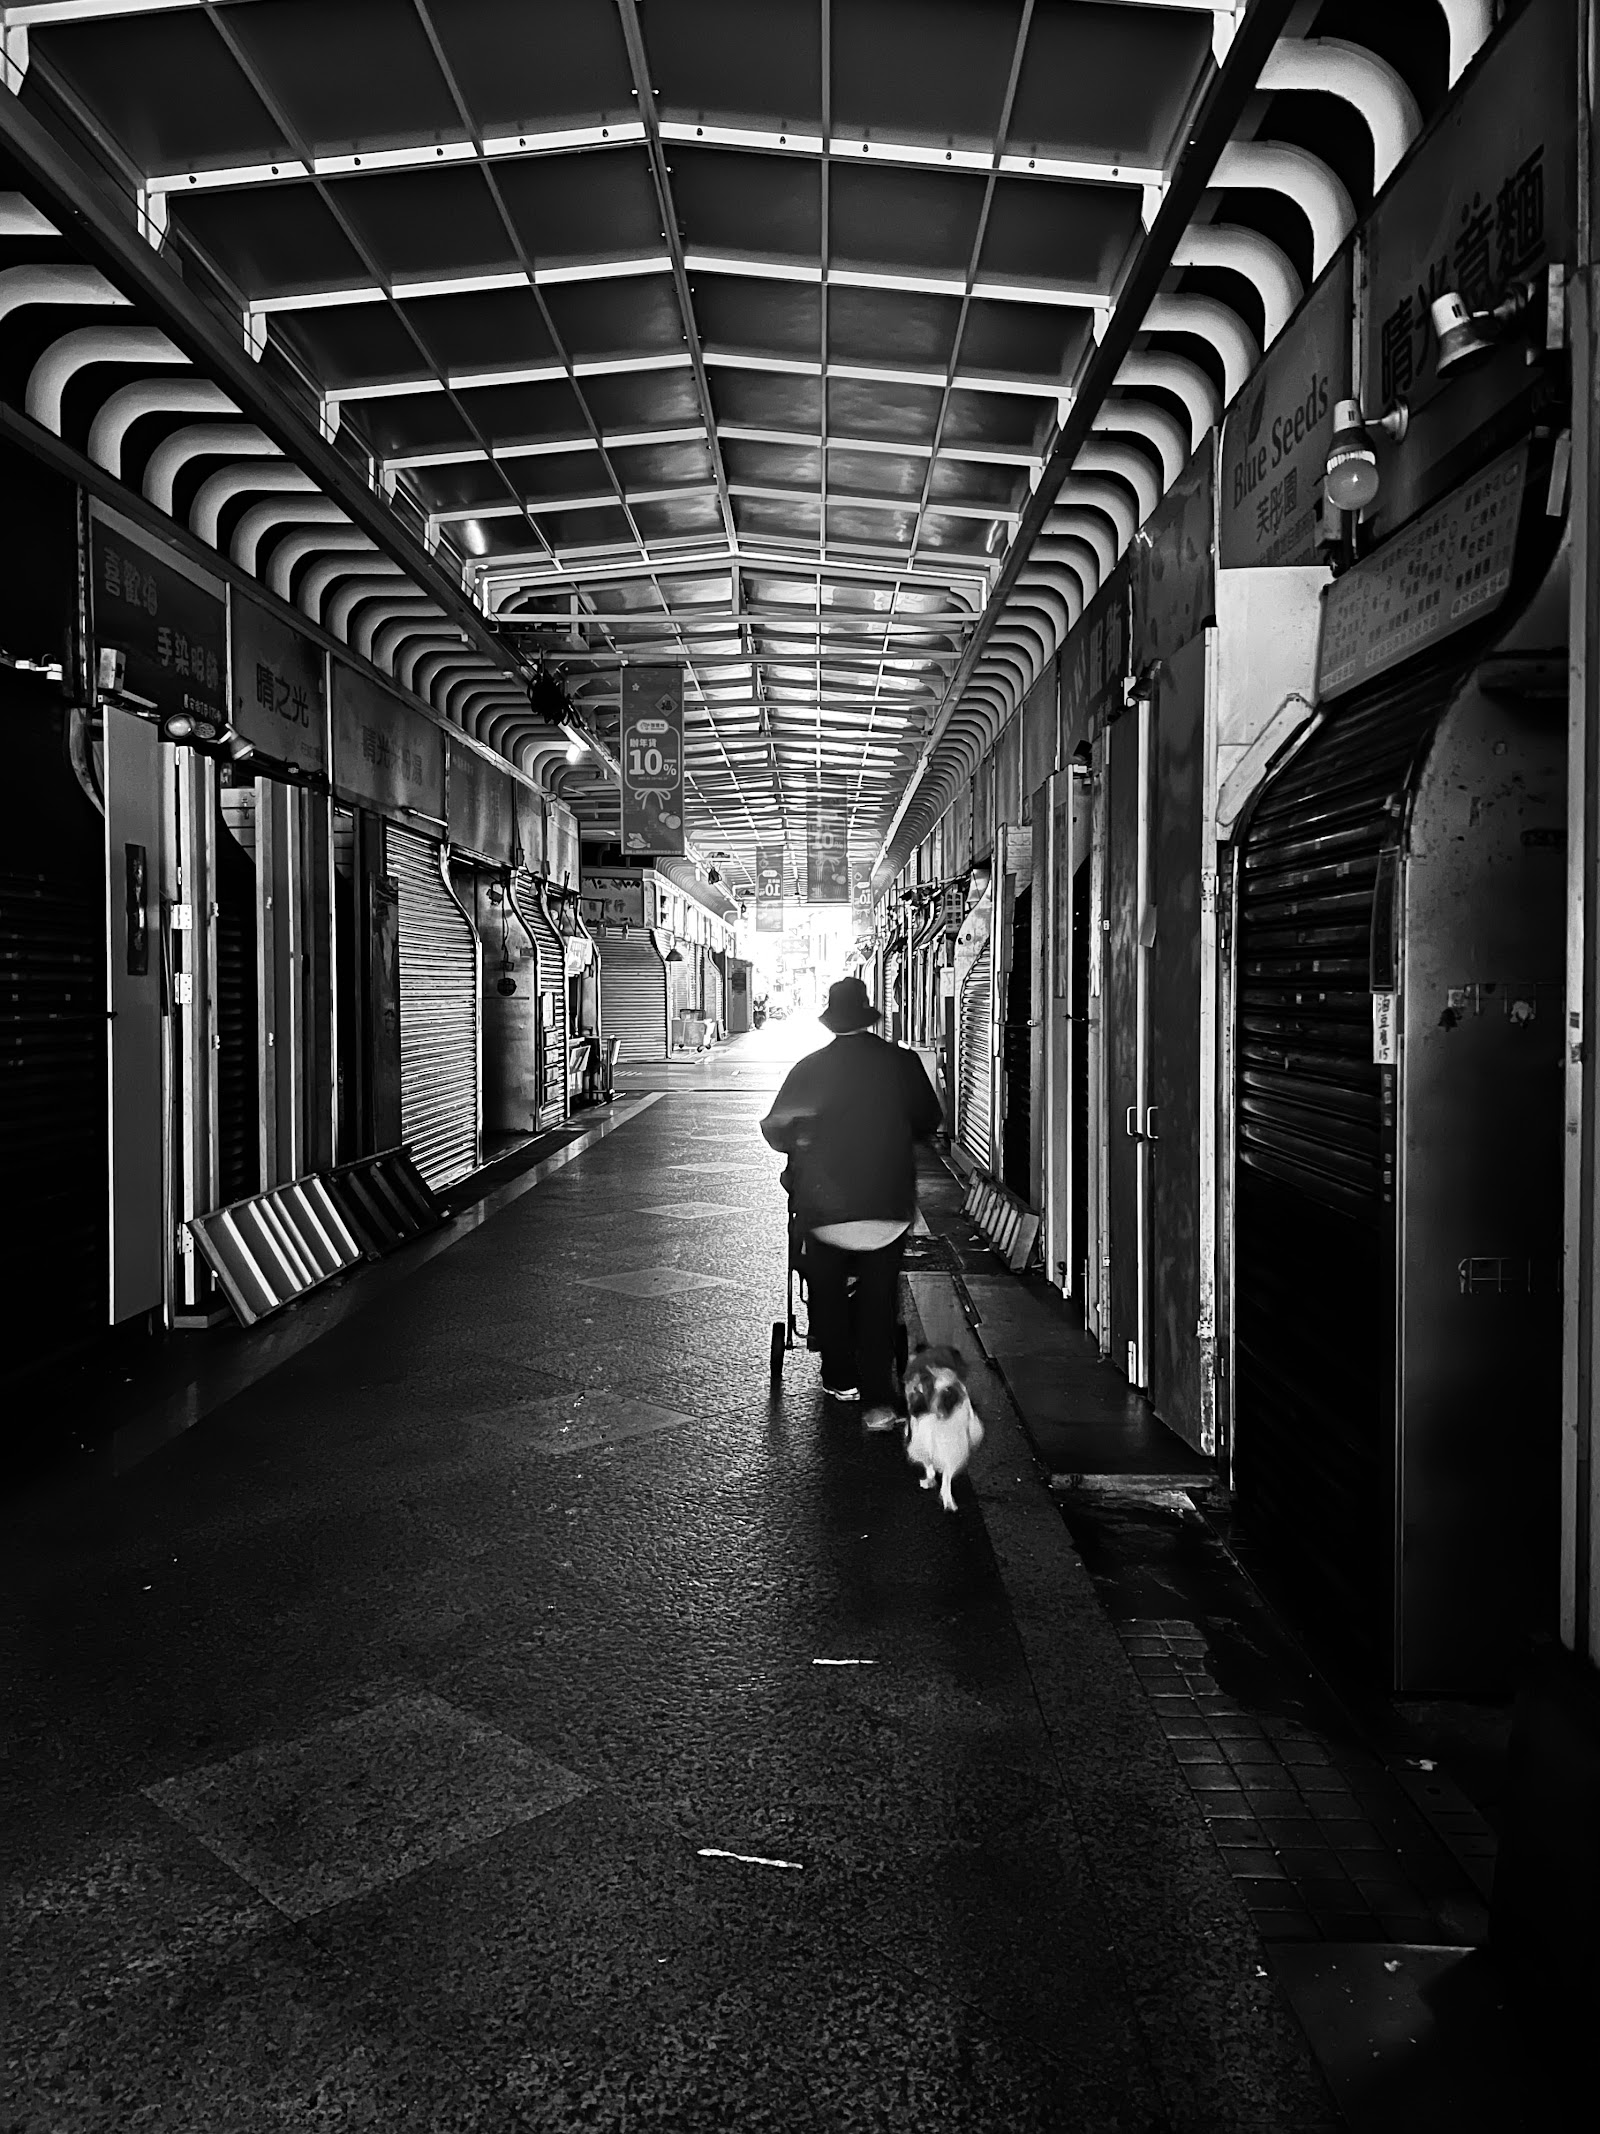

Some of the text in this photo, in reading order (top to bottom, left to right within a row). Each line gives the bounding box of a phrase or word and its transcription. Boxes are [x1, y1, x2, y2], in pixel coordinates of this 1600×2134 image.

[1233, 437, 1268, 511] Blue
[1271, 372, 1329, 469] Seeds
[255, 661, 310, 729] 晴之光
[629, 748, 678, 776] 10%
